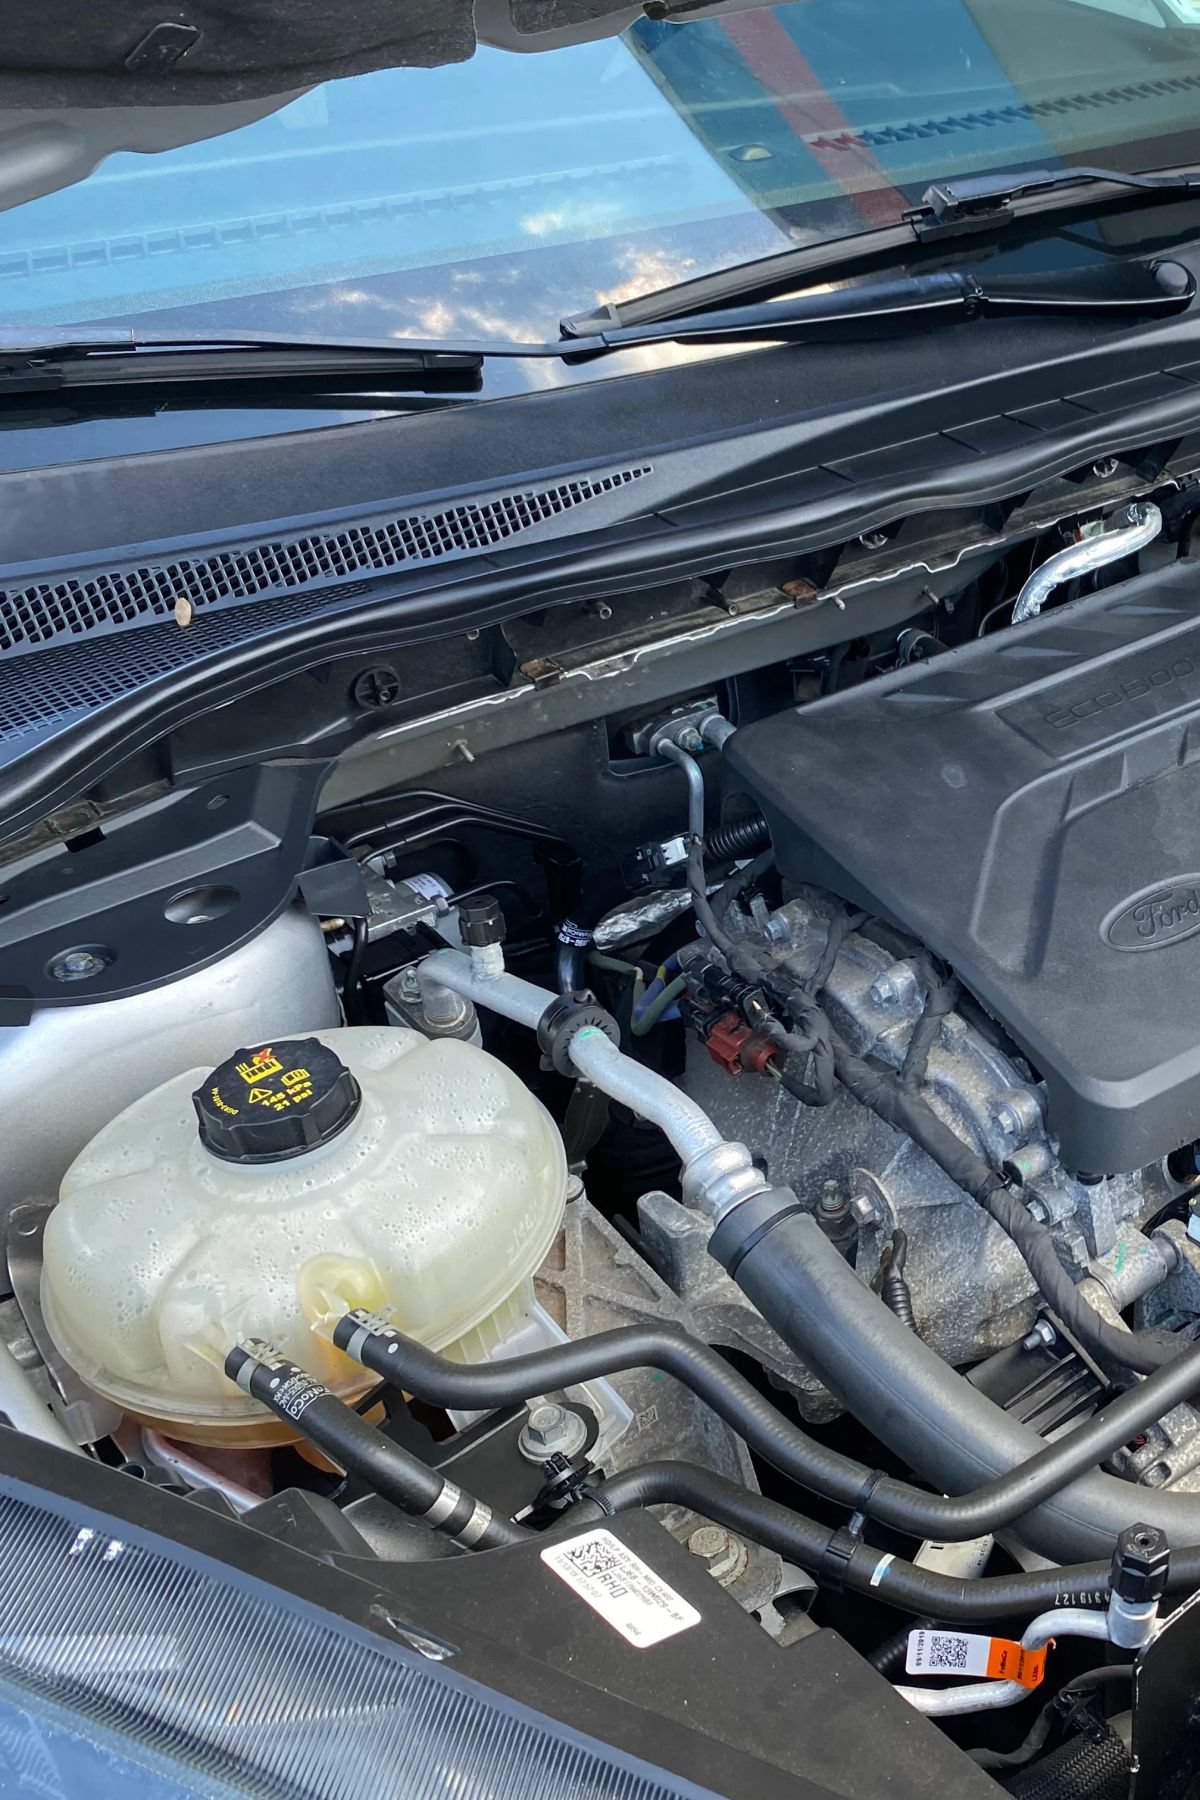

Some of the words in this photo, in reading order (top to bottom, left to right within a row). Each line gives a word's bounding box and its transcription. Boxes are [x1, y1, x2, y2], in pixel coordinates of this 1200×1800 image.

[261, 1091, 286, 1107] 145
[285, 1080, 313, 1096] kPa
[273, 1099, 291, 1112] 21
[292, 1088, 313, 1104] psi
